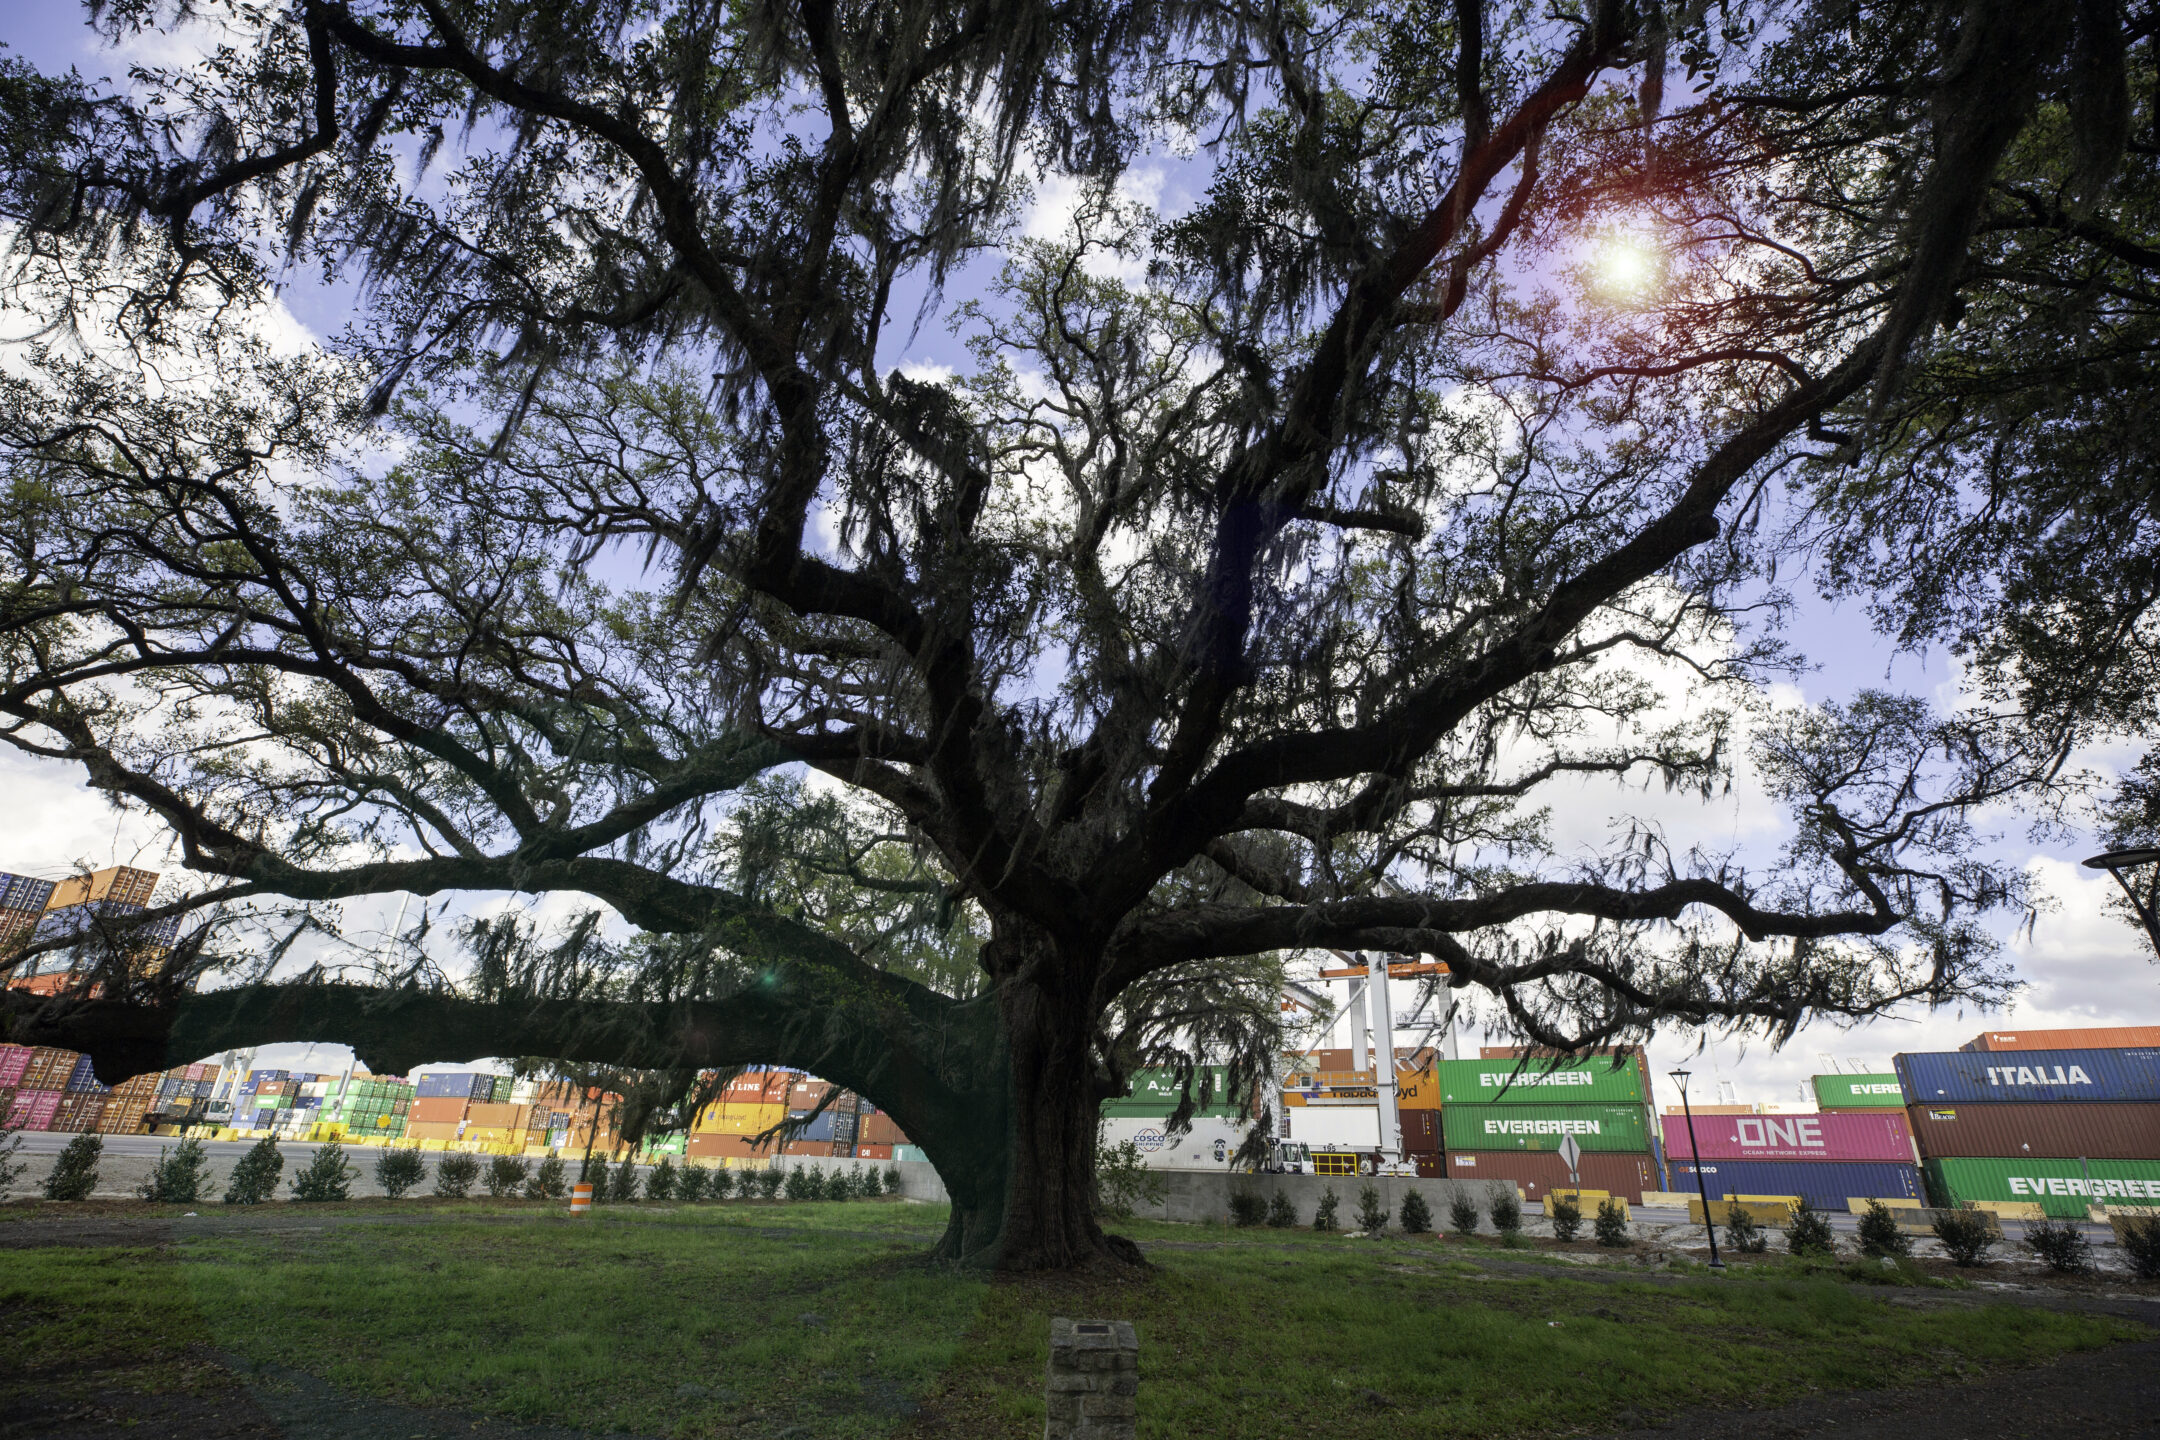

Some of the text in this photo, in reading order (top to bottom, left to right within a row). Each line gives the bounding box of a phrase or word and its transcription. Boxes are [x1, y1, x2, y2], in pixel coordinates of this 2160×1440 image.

[1480, 1071, 1593, 1087] EVERGREEN
[1986, 1065, 2092, 1086] ITALIA
[1484, 1119, 1601, 1135] EVERGREEN
[1736, 1118, 1825, 1147] ONE
